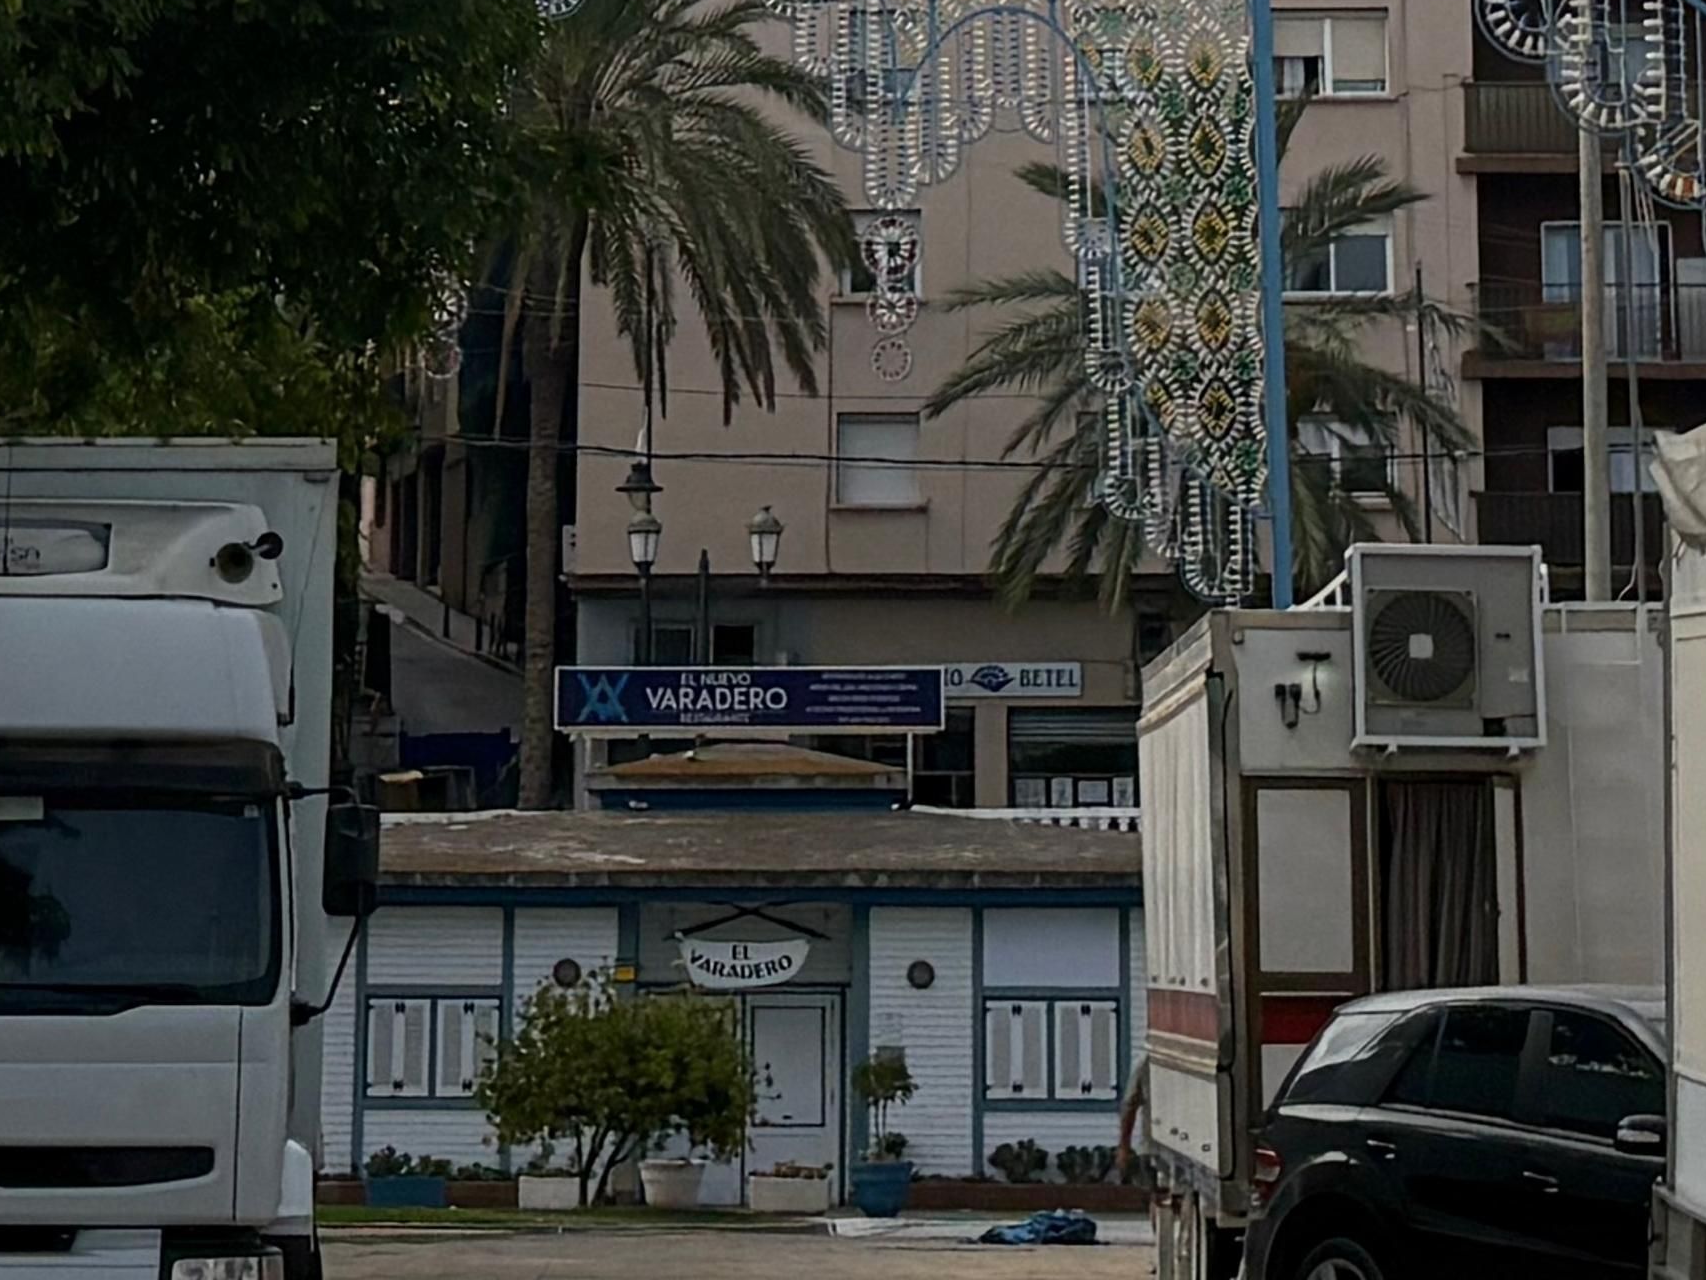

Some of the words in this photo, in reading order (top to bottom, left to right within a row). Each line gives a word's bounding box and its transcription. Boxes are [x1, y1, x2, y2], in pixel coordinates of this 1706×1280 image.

[681, 672, 697, 686] EL
[1019, 668, 1078, 687] BETEL
[646, 687, 788, 710] VARADERO
[731, 944, 752, 961] EL
[689, 948, 793, 979] VARADERO
